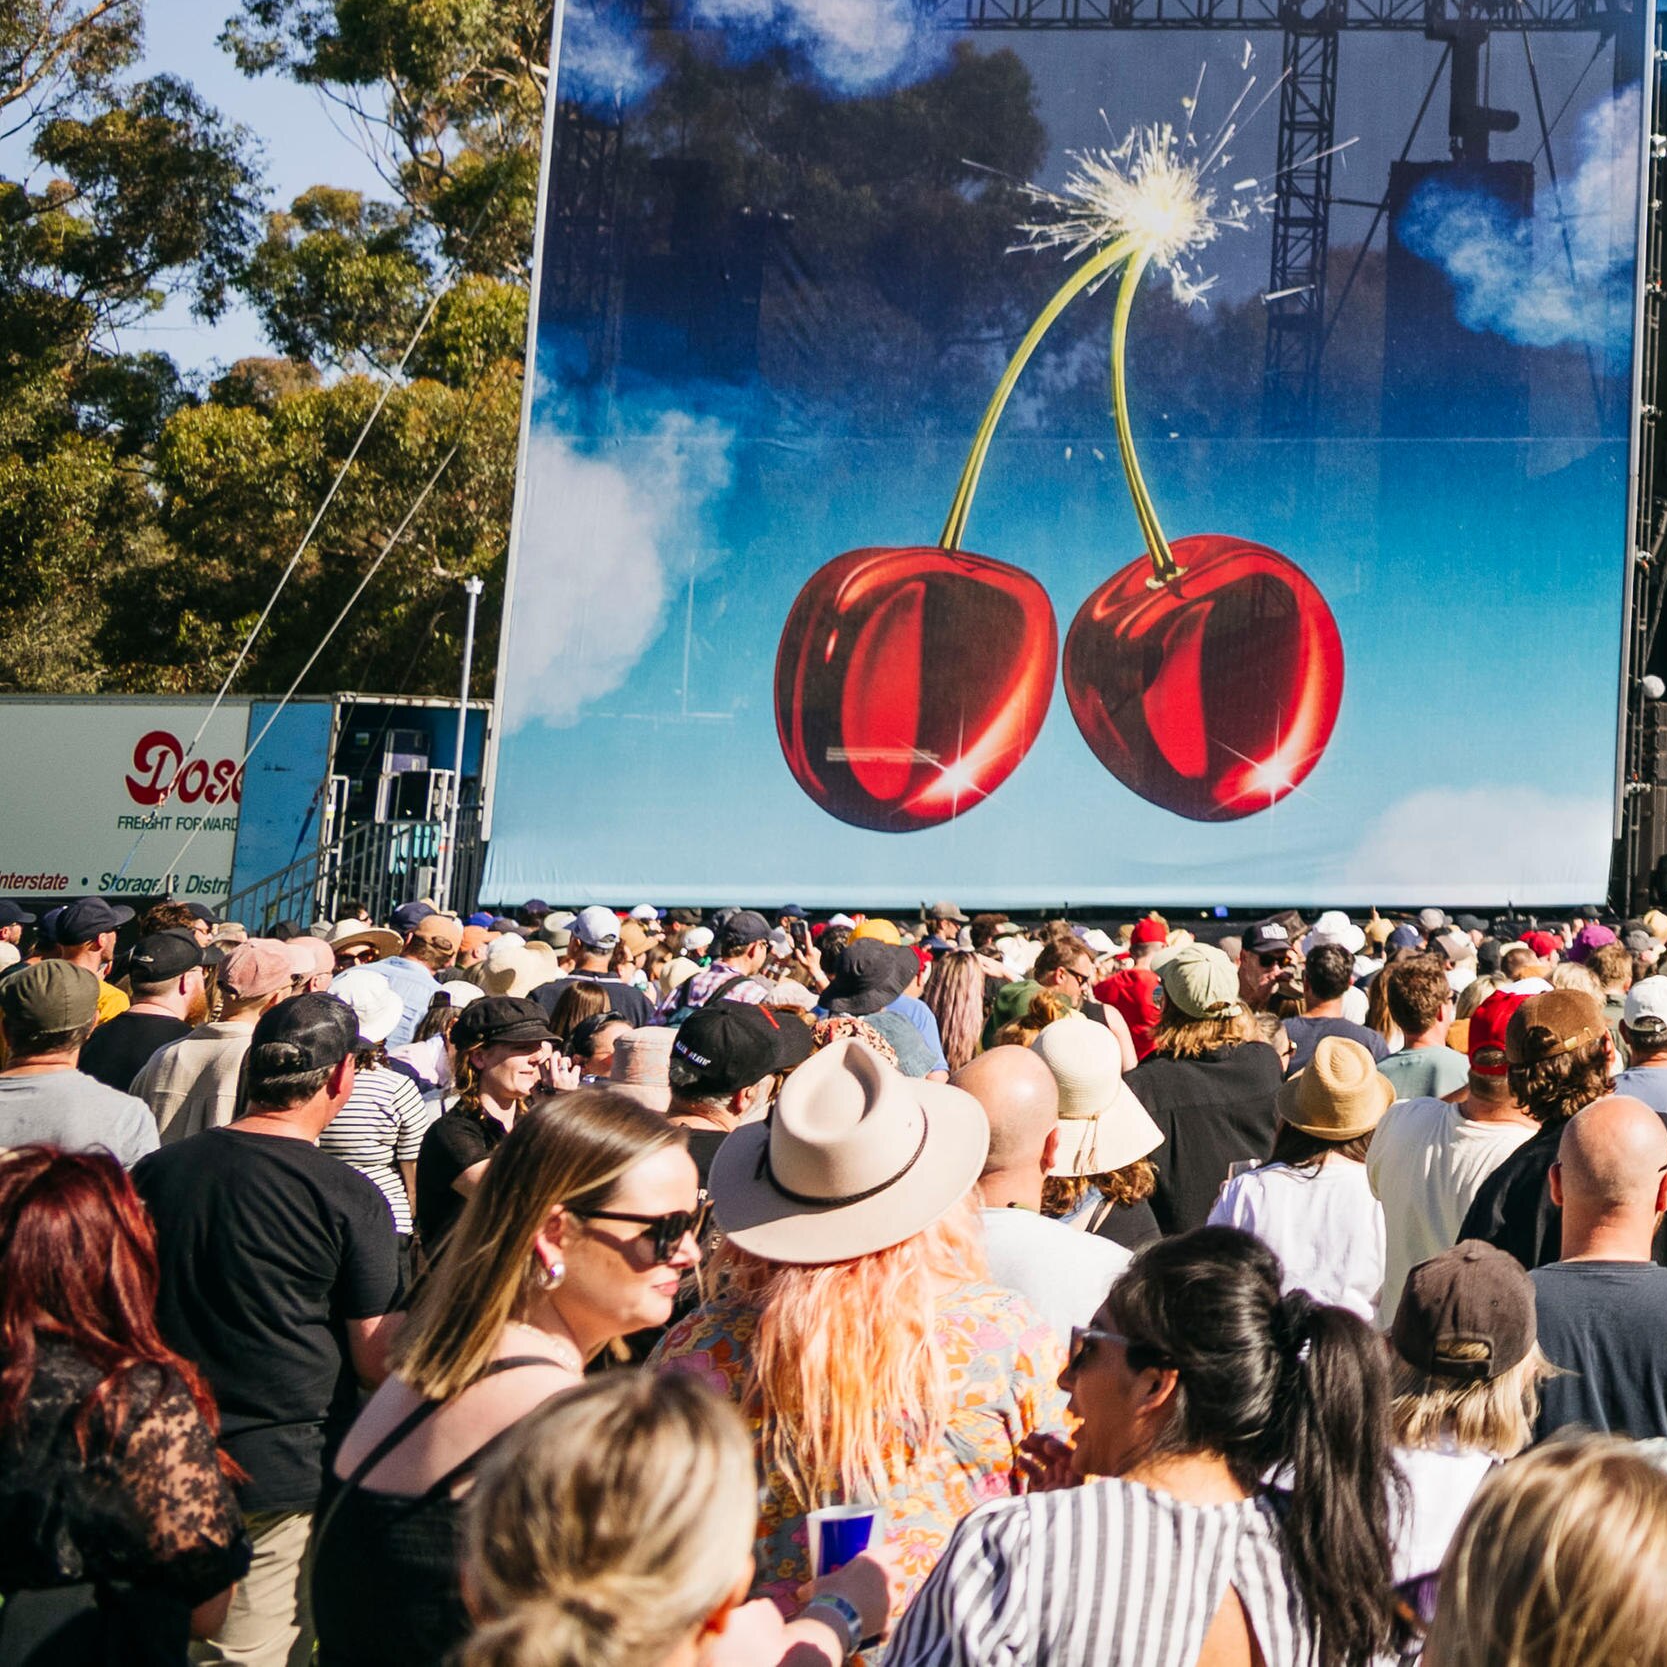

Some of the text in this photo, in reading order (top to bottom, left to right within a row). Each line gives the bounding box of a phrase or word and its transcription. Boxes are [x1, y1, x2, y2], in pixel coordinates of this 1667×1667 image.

[117, 816, 172, 830] FREIGHT
[0, 871, 69, 890] nterstate
[98, 873, 161, 896] Storage
